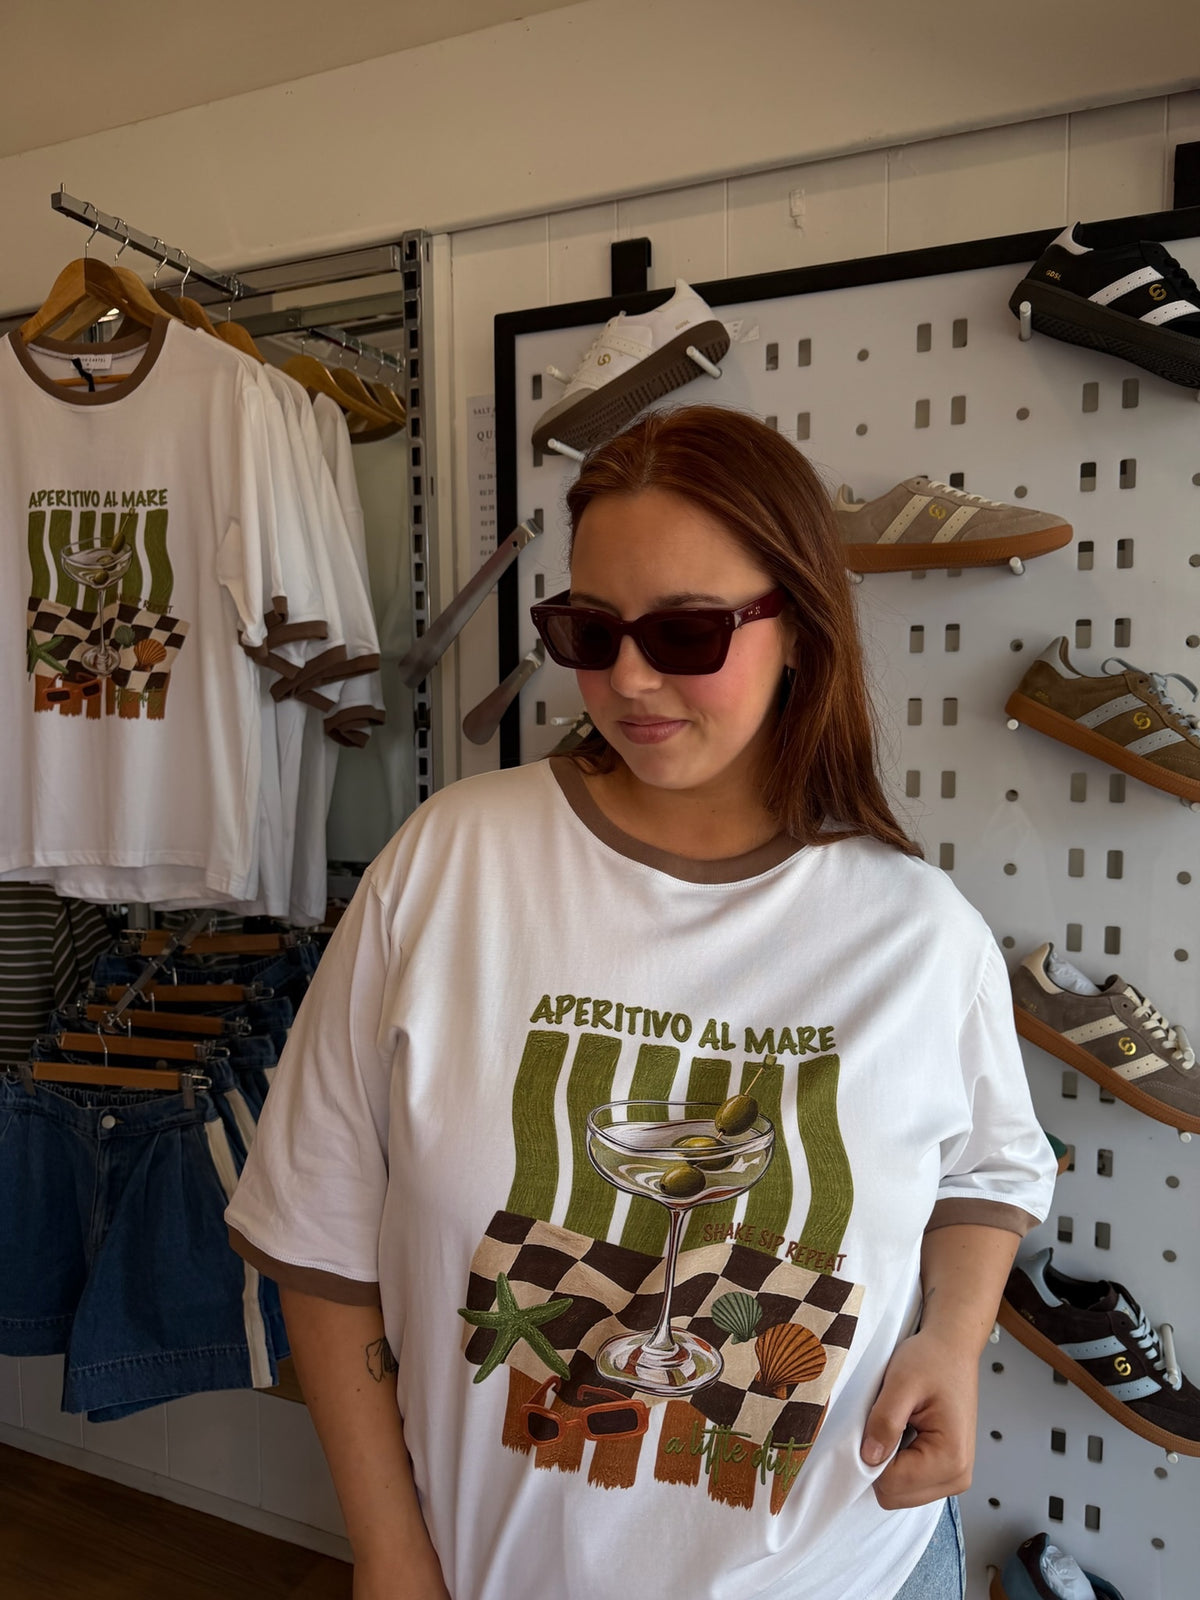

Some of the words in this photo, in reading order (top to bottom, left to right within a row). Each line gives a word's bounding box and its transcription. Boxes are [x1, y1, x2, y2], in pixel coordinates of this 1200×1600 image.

[477, 430, 495, 442] QU
[28, 489, 100, 508] APERITIVO
[103, 490, 118, 507] AL
[121, 488, 168, 508] MARE
[529, 994, 692, 1043] APERITIVO
[698, 1018, 736, 1051] AL
[743, 1026, 836, 1055] MARE
[703, 1222, 756, 1242] SHAKE
[758, 1228, 785, 1251] SIP
[785, 1241, 847, 1272] REPEAT
[664, 1436, 684, 1454] a
[690, 1420, 752, 1486] little
